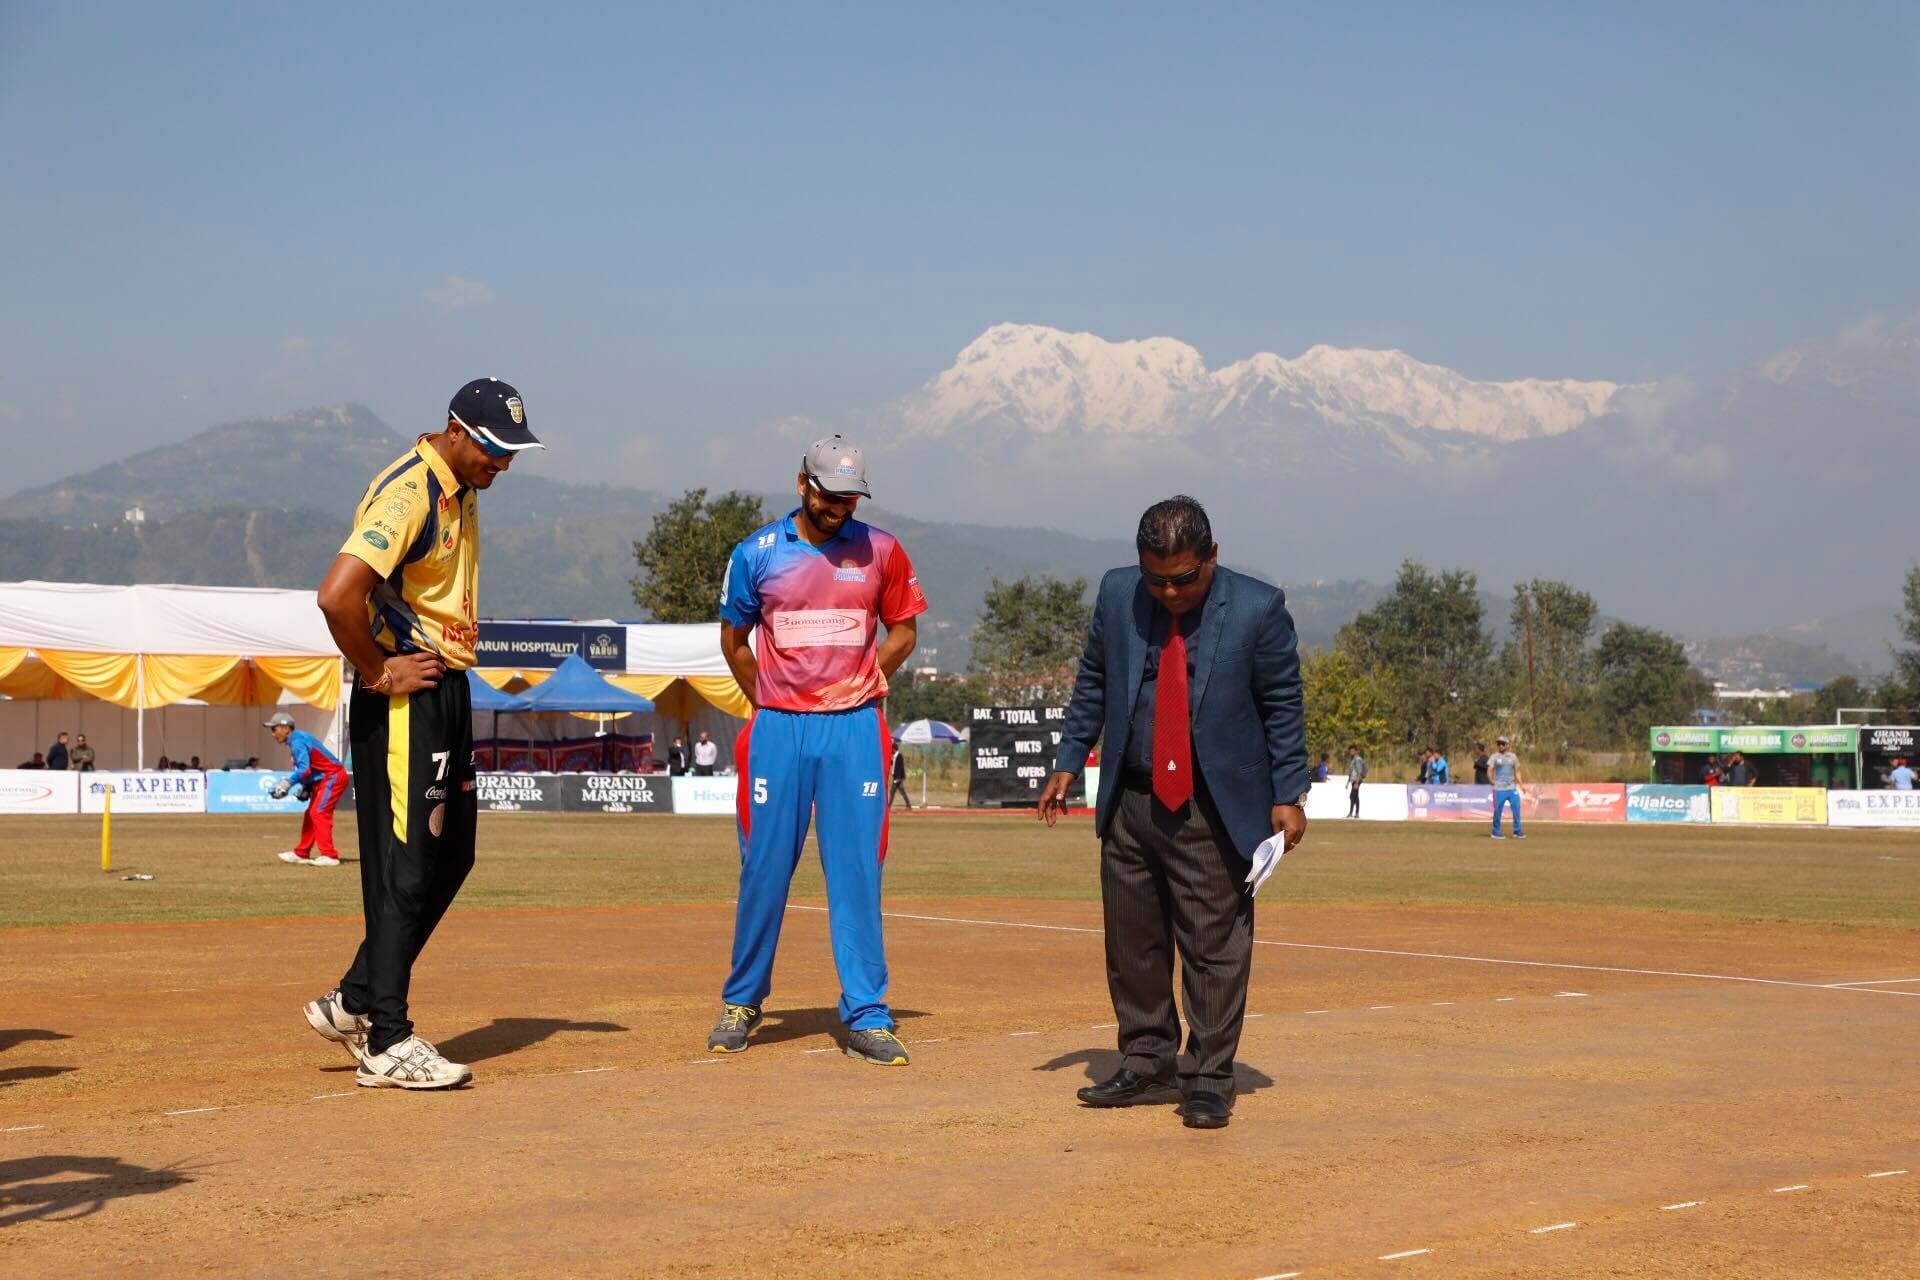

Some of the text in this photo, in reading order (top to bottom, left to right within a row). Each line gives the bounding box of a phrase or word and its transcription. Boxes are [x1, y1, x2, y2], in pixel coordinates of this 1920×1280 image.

[776, 616, 845, 627] Boomerang
[512, 642, 578, 653] HOSPITALITY
[590, 645, 618, 656] VARUN
[974, 708, 992, 719] BAT.
[1006, 710, 1038, 724] TOTAL
[1045, 708, 1065, 719] BAT.
[1720, 734, 1759, 745] PLAYER
[1760, 734, 1781, 745] BOX
[1874, 730, 1910, 738] GRAND
[1015, 741, 1041, 753] WKTS
[432, 750, 450, 780] 7
[976, 757, 1009, 769] TARGET
[1017, 767, 1046, 778] OVERS
[122, 778, 198, 792] EXPERT
[476, 776, 536, 788] GRAND
[587, 776, 646, 790] GRAND
[582, 789, 654, 802] MASTER
[754, 778, 768, 804] 5
